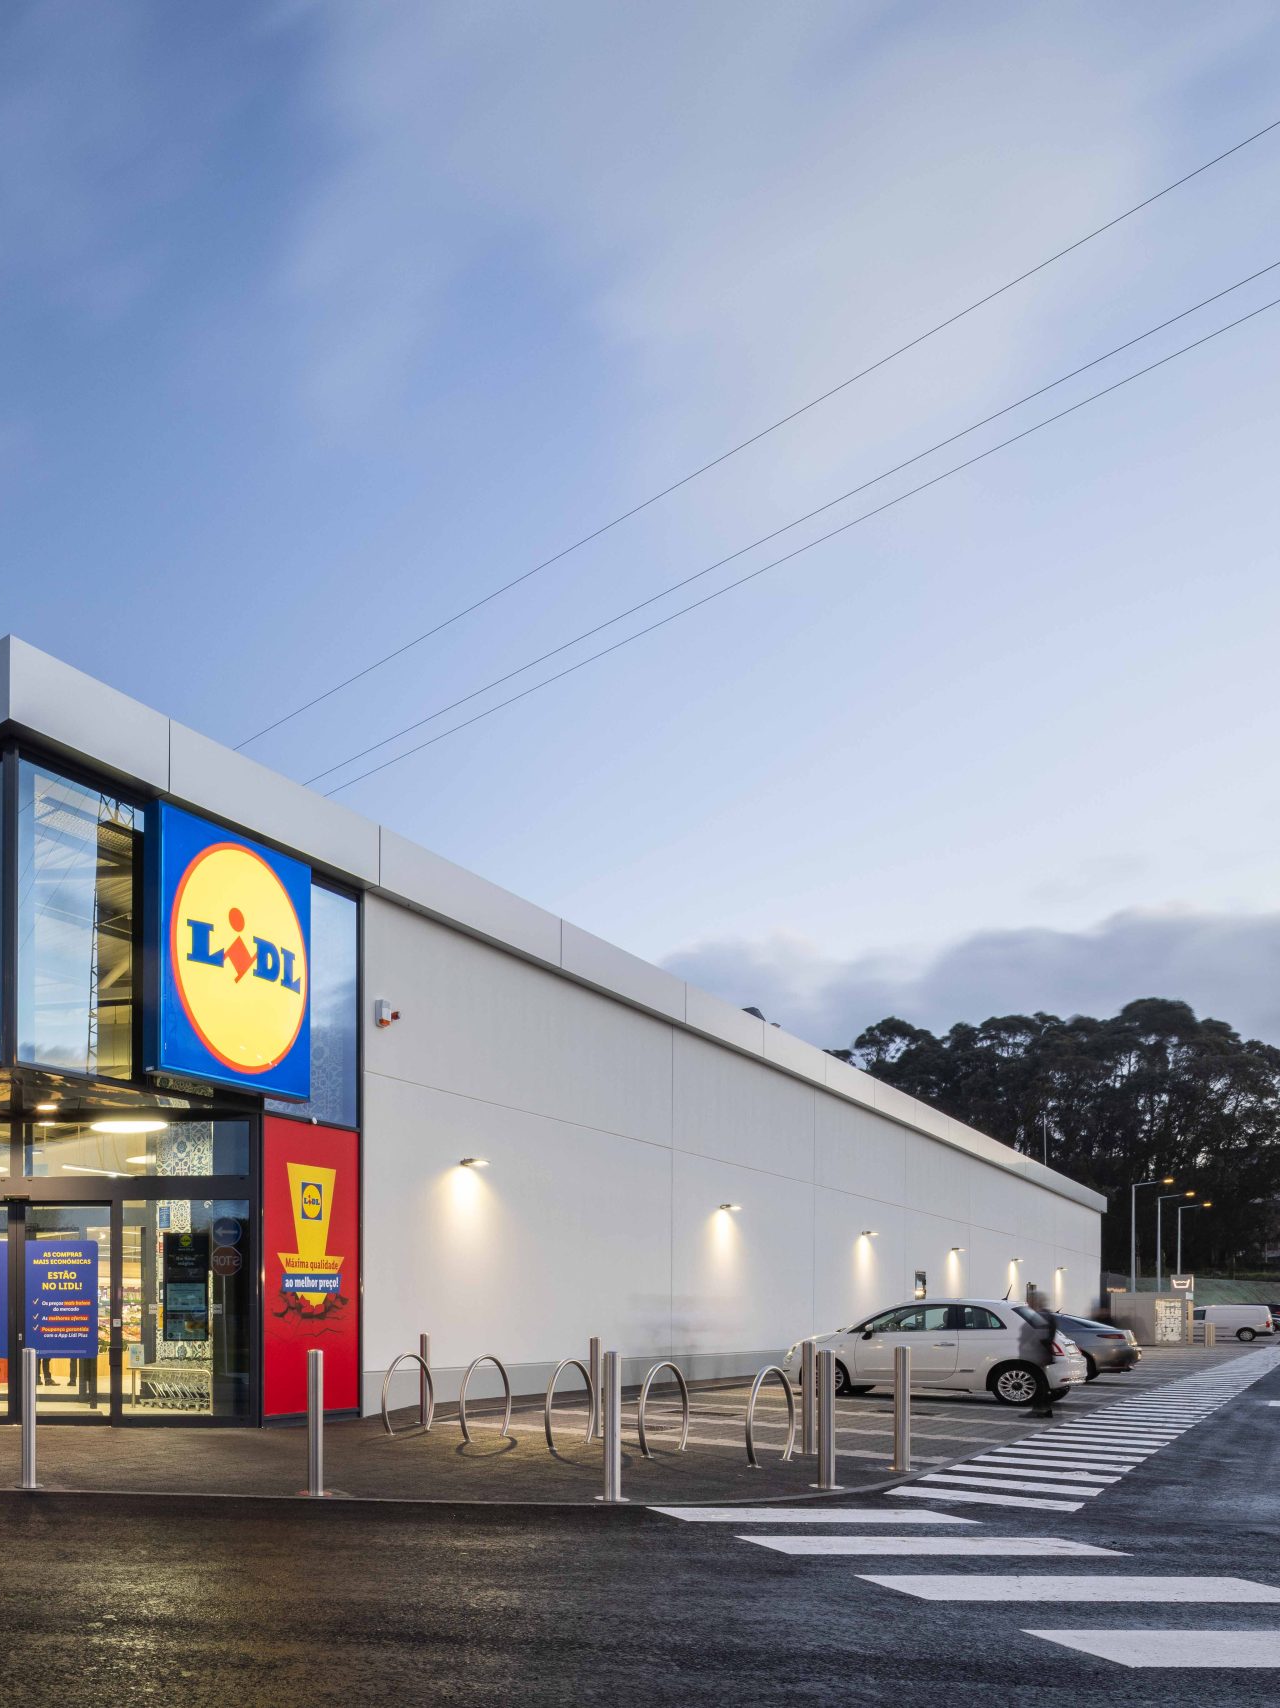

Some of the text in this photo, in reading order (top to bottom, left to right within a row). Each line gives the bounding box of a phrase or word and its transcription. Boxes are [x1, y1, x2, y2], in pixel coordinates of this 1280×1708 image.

[285, 1257, 338, 1271] Máxima qualidade
[47, 1270, 77, 1280] ESTÃO
[42, 1282, 83, 1290] NO LIDL!
[285, 1276, 339, 1291] ao melhor preço!
